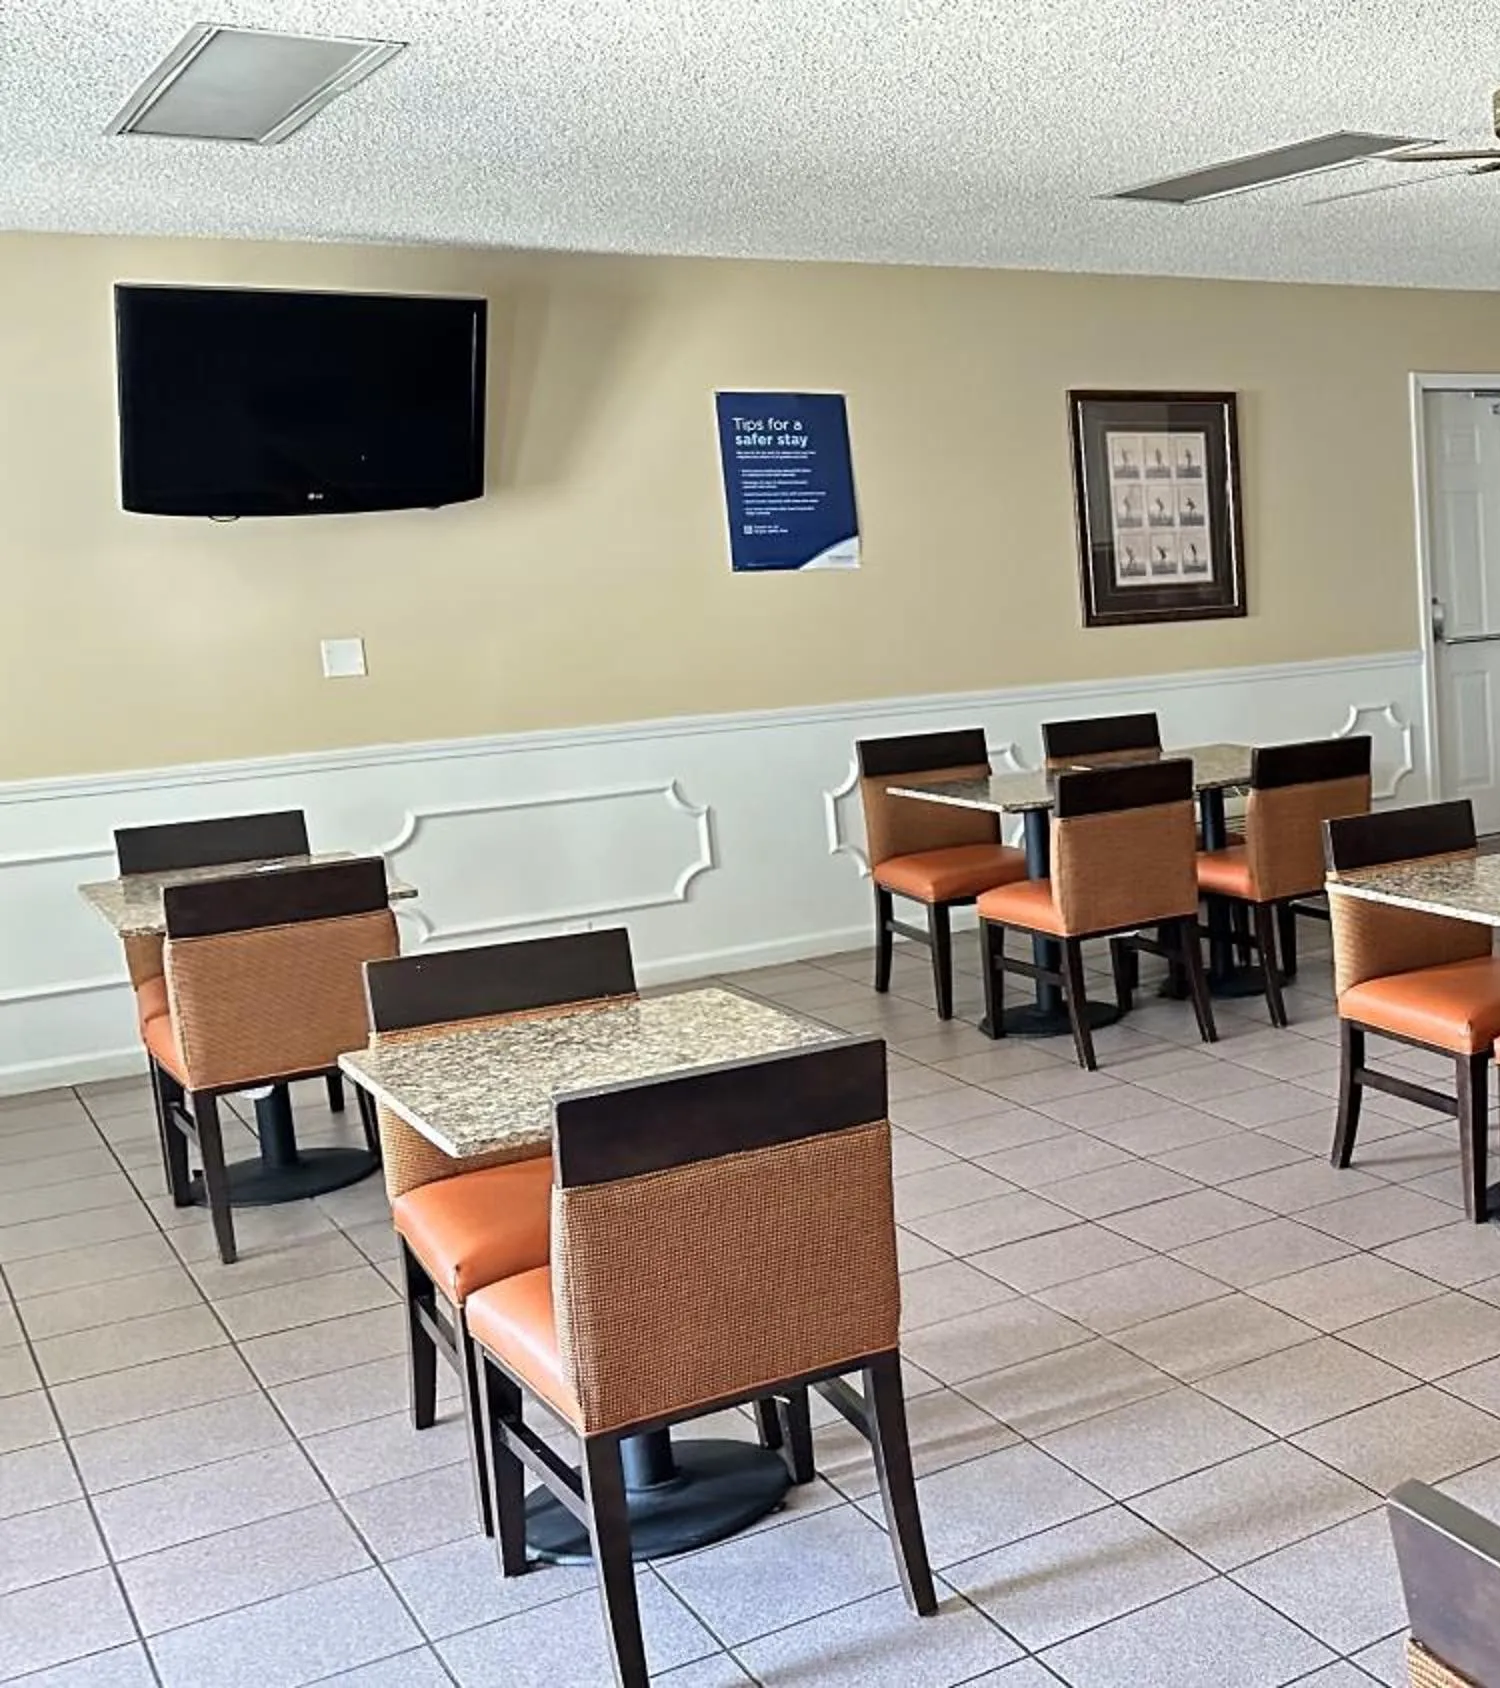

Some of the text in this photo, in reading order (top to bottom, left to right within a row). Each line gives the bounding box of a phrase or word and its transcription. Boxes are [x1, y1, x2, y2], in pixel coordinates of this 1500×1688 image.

[732, 417, 803, 432] Tips for a
[735, 432, 808, 448] safer stay
